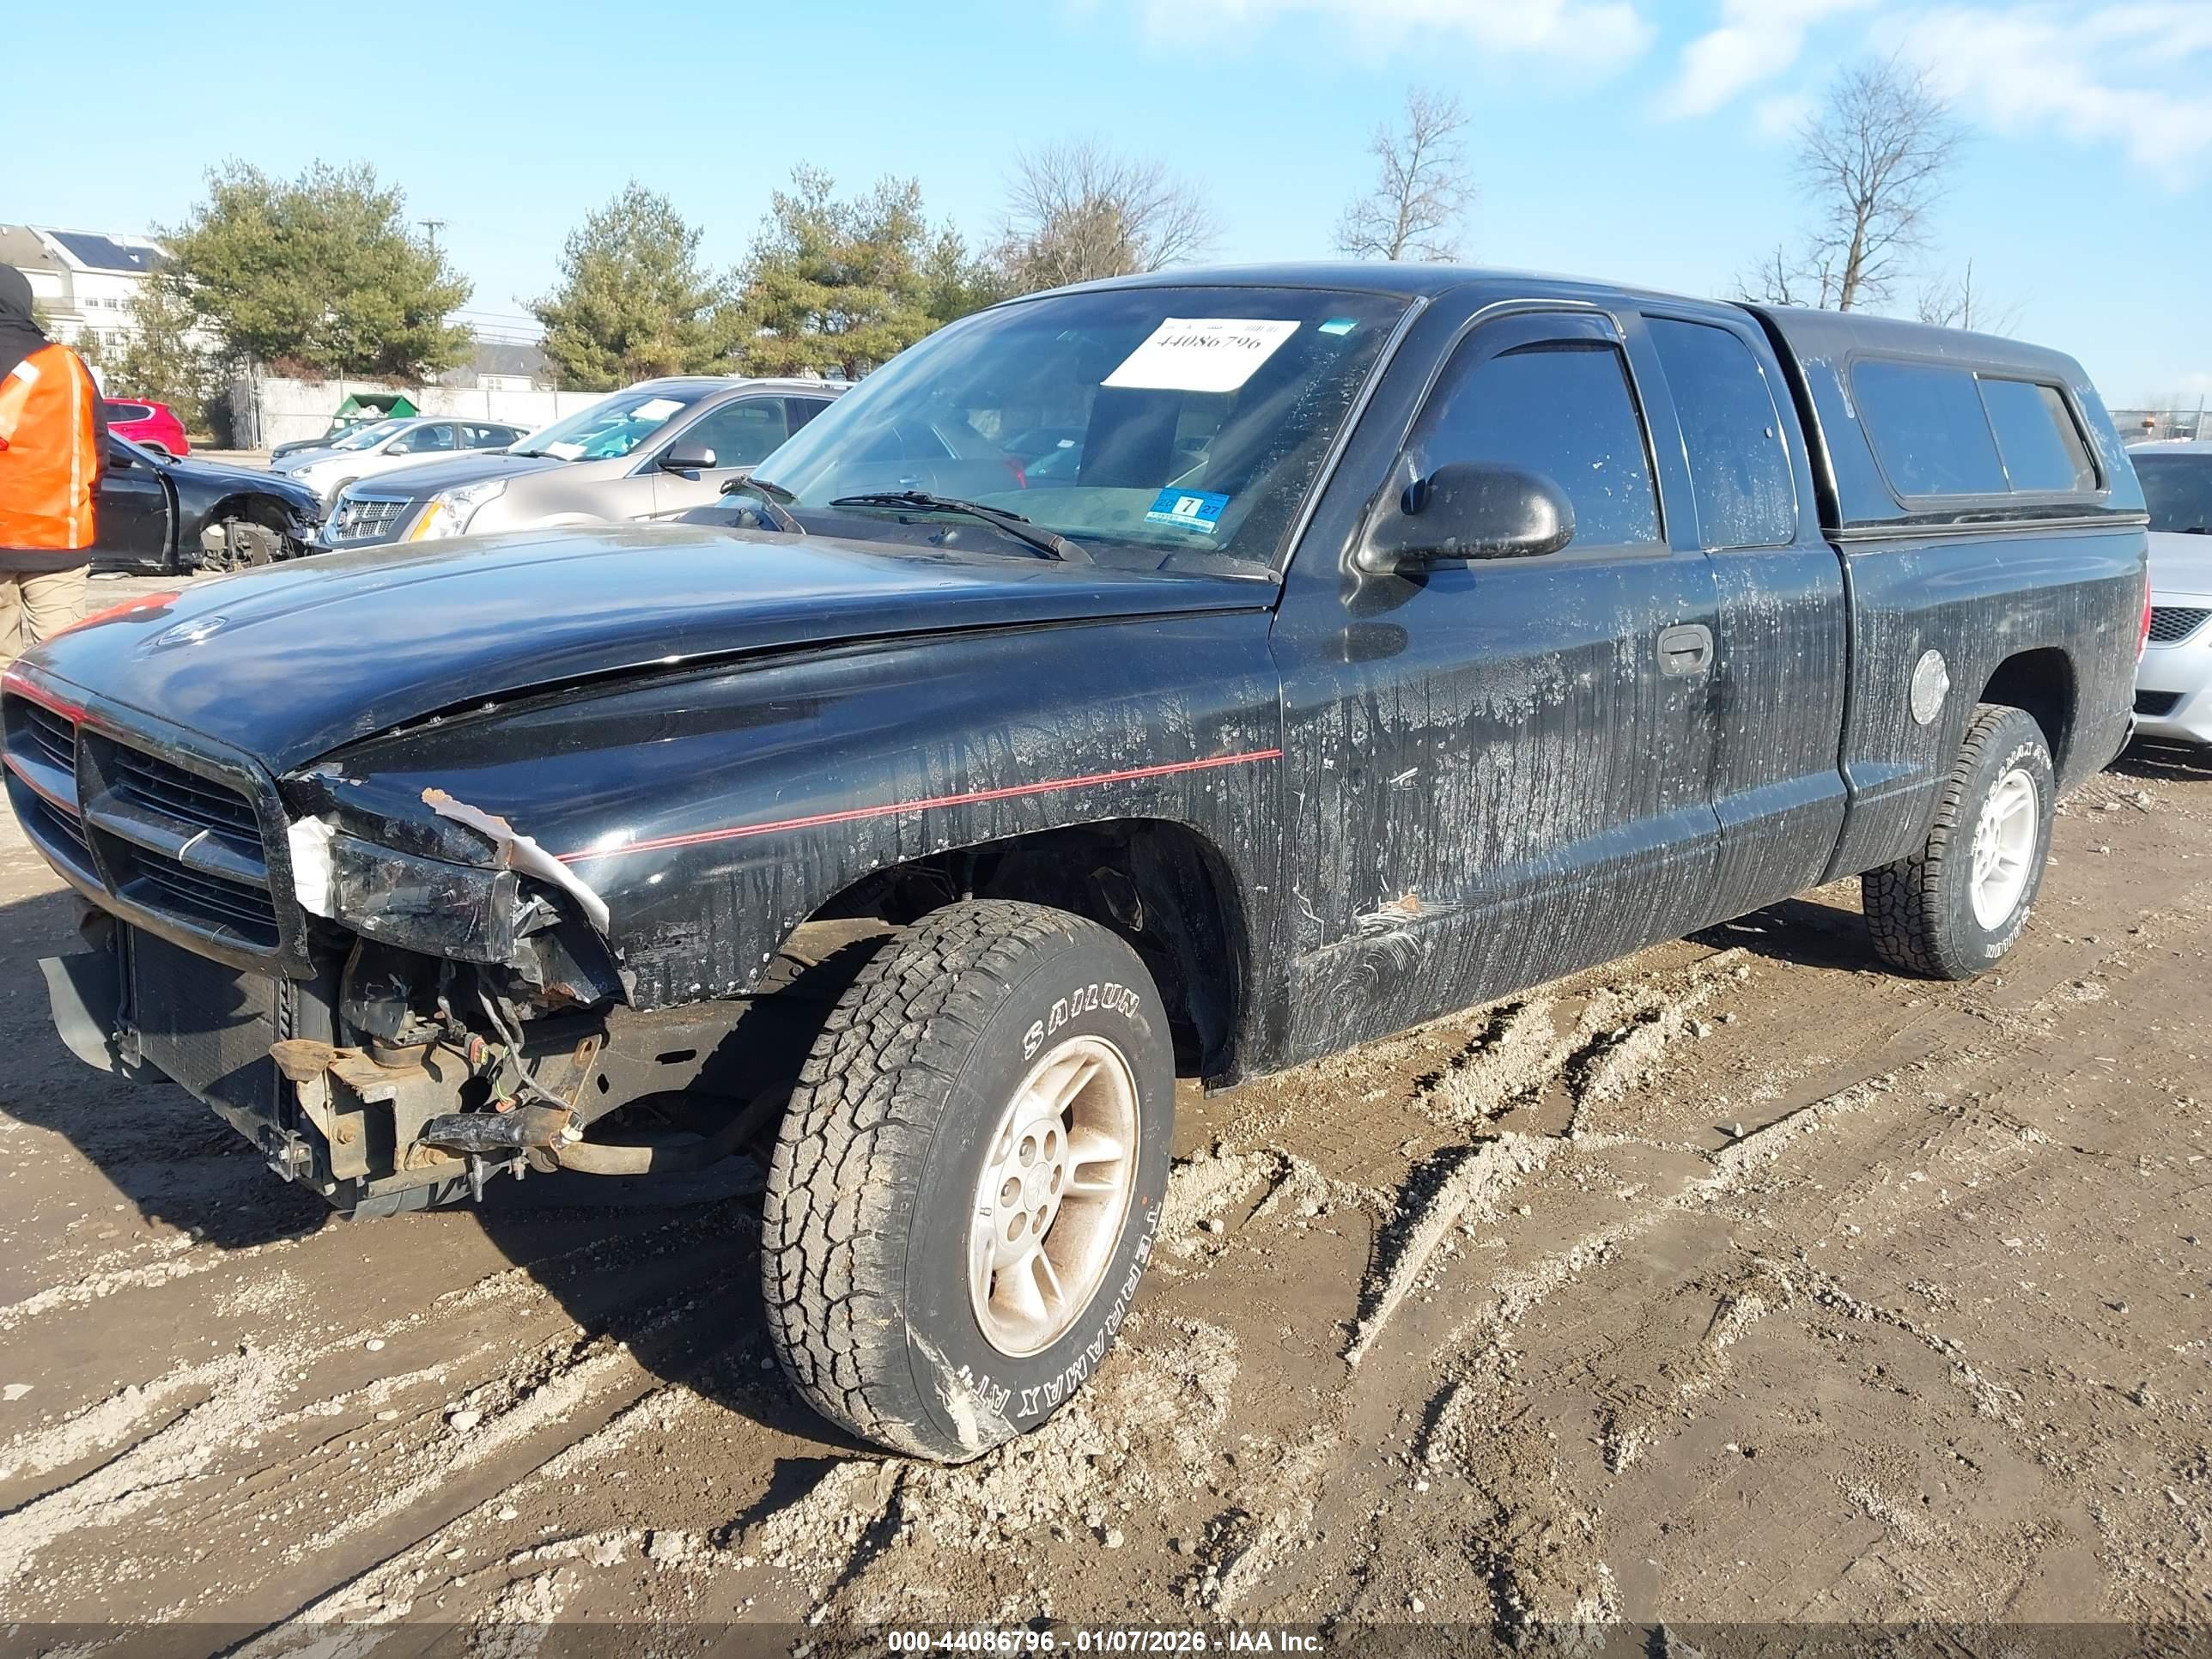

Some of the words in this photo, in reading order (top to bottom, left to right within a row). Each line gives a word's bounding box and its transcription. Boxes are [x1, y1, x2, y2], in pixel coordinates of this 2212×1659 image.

[1157, 335, 1261, 350] 44086796
[1182, 499, 1195, 513] 7
[1202, 505, 1219, 515] 27
[1023, 981, 1140, 1060] SAILUN
[1017, 1201, 1162, 1418] TERRAMAX
